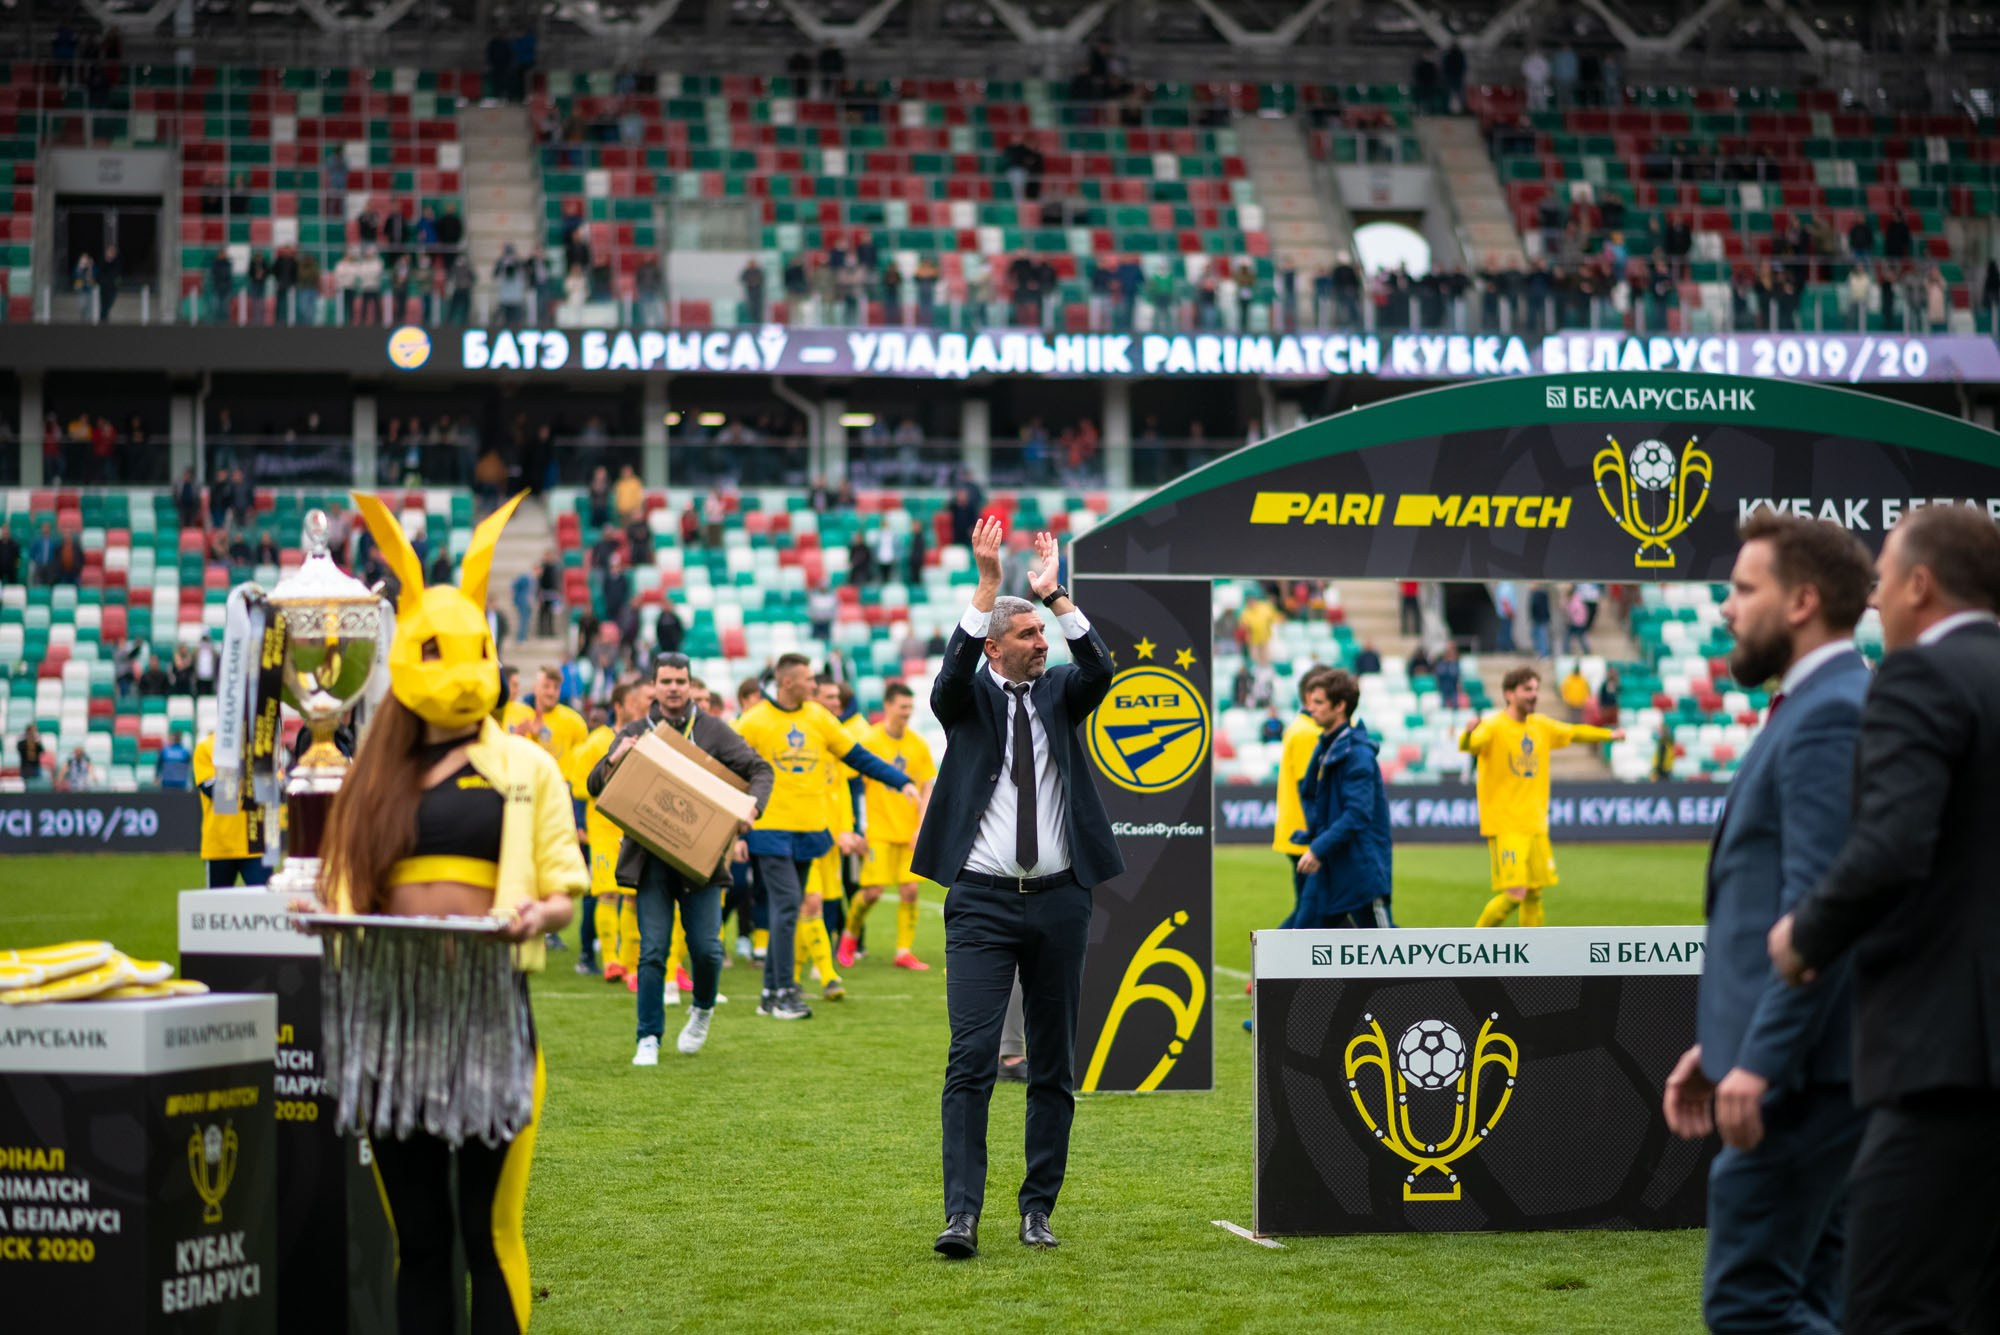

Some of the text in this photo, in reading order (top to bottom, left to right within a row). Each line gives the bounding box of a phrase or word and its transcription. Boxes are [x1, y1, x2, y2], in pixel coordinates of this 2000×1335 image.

[463, 330, 570, 370] БАТЭ
[581, 325, 789, 371] БАРЫСАЎ
[849, 333, 1132, 378] УЛАДАЛЬНІК
[1142, 335, 1380, 374] PARIMATCH
[1392, 335, 1531, 374] КУБКА
[1542, 336, 1739, 374] БЕЛАРУСІ
[1752, 336, 1929, 384] 2019/20
[1573, 387, 1756, 411] БЕЛАРУСБАНК
[1250, 492, 1571, 529] PARI MATCH
[1115, 694, 1179, 708] БАТЭ
[38, 806, 159, 842] 2019/20
[1579, 797, 1674, 826] КУБКА
[1340, 943, 1530, 966] БЕЛАРУСБАНК
[13, 1207, 121, 1234] БЕЛАРУСІ
[37, 1237, 95, 1262] 2020
[176, 1231, 247, 1274] КУБАК
[162, 1266, 261, 1314] БЕЛАРУСІ
